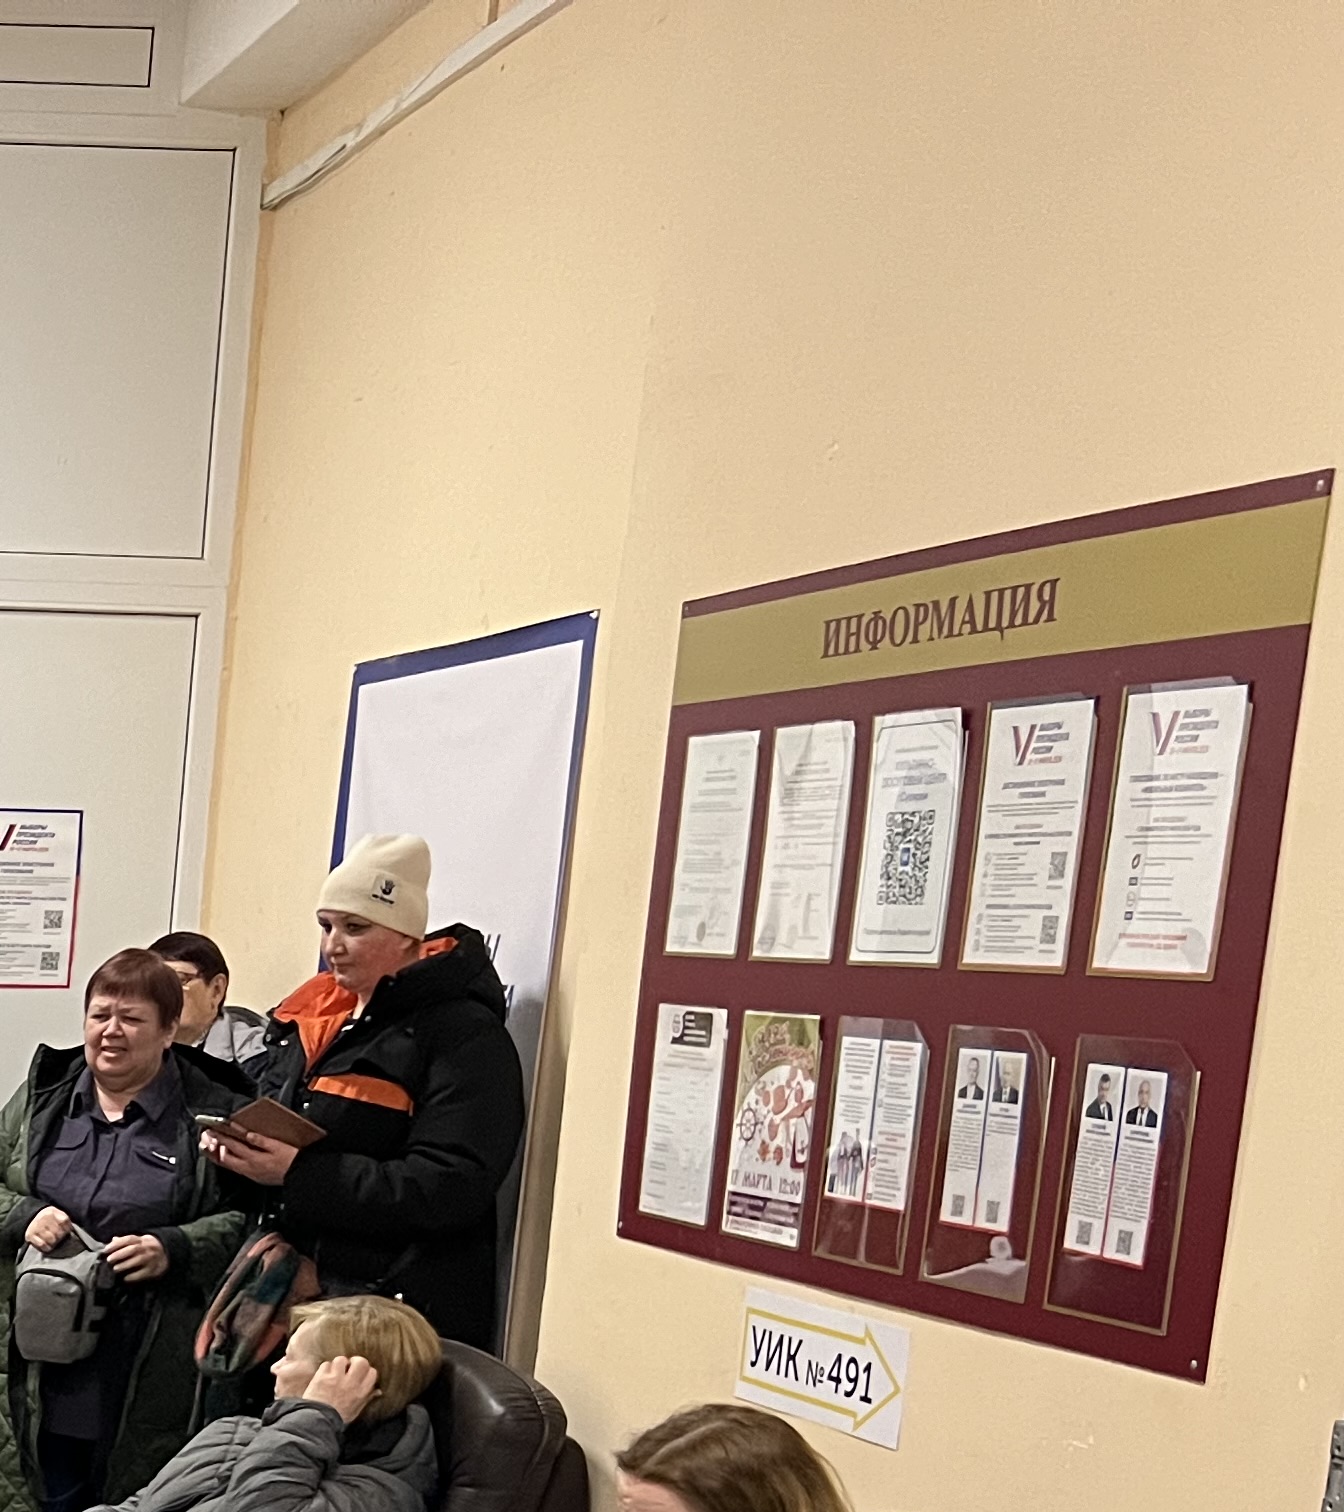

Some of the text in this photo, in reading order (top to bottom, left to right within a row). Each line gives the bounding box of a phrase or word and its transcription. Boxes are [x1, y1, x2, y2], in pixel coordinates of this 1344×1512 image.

[820, 578, 1061, 659] ИНФОРМАЦИЯ
[742, 1171, 772, 1191] МАРТА
[750, 1324, 803, 1382] УИК
